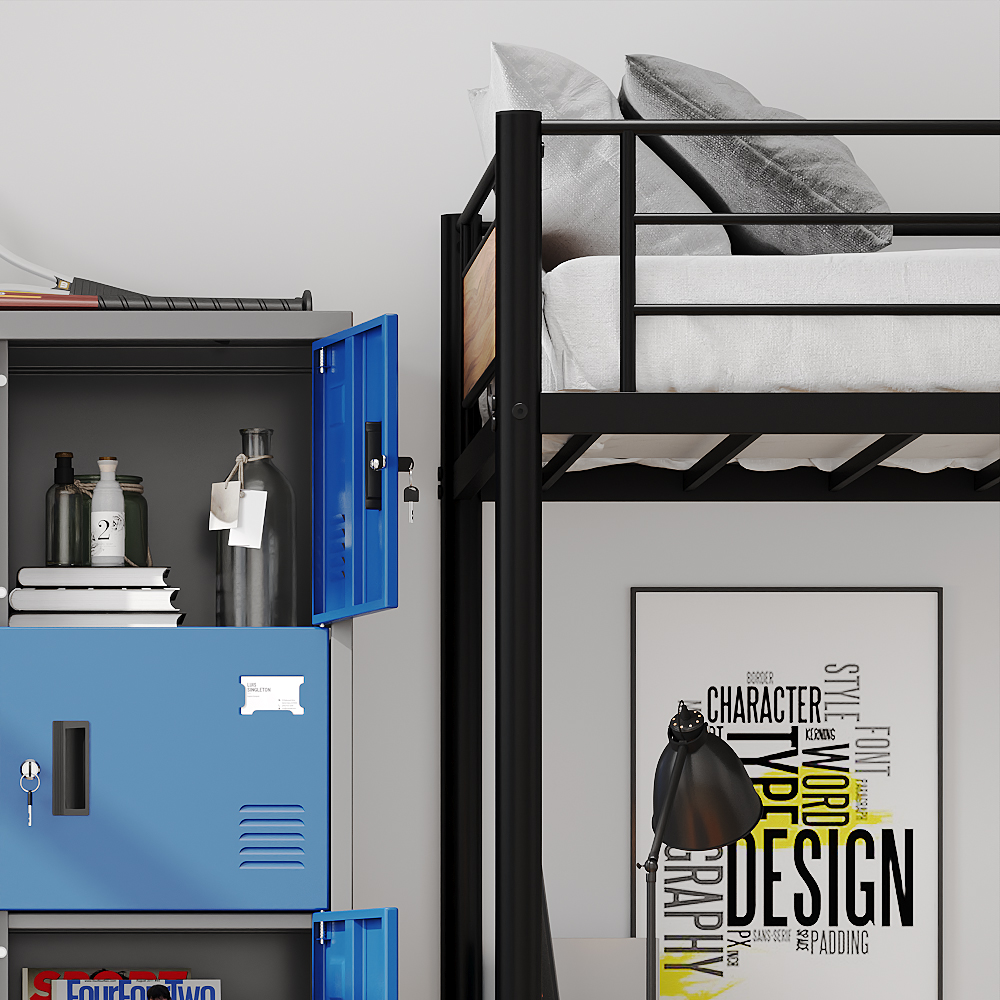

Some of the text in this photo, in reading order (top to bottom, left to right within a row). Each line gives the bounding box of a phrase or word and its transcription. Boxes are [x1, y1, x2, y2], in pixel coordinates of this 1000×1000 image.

[98, 519, 110, 540] 2
[746, 671, 774, 684] BORDER
[824, 663, 860, 722] STYLE
[707, 685, 822, 723] CHARACTER
[855, 726, 891, 777] FONT
[726, 726, 799, 825] TYPE
[801, 743, 850, 827] WORD
[726, 828, 914, 927] DESIGN
[727, 930, 751, 948] PX
[811, 930, 869, 955] PADDING
